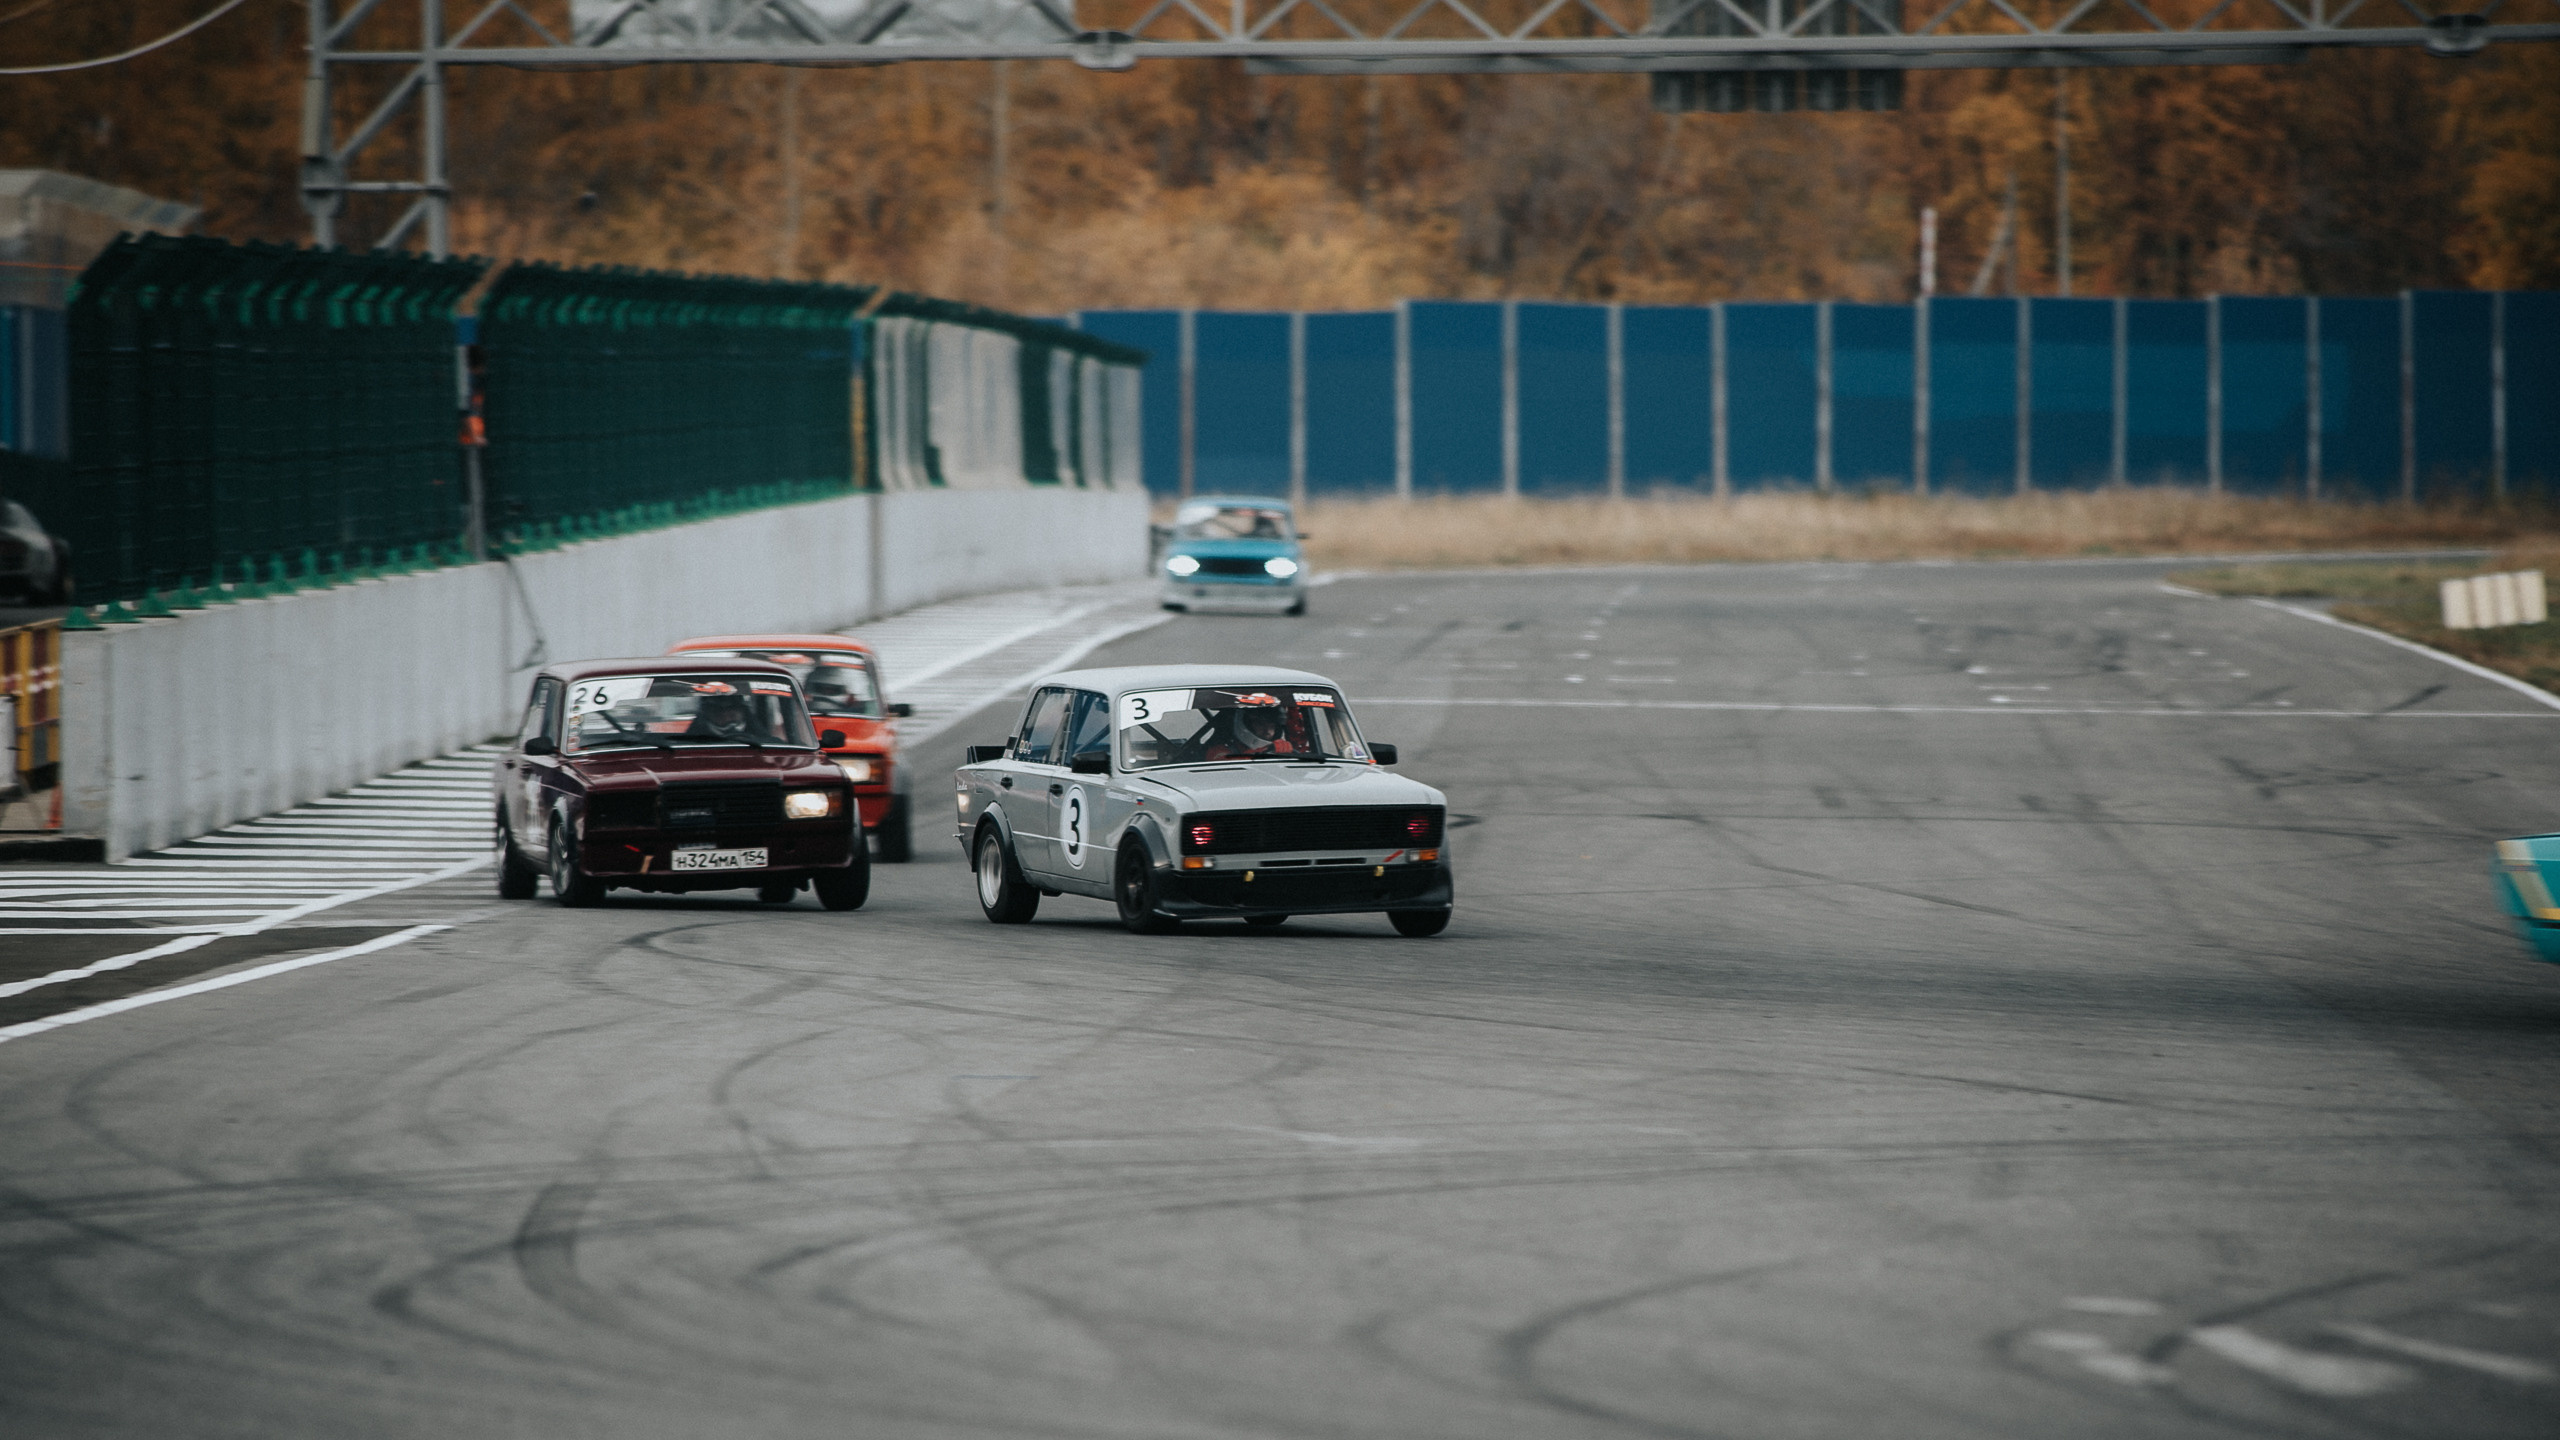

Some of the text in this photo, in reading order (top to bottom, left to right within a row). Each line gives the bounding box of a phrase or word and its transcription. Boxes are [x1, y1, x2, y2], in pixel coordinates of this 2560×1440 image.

[574, 687, 608, 705] 26
[1131, 698, 1150, 720] 3
[1069, 798, 1080, 855] 3
[741, 851, 765, 862] 154
